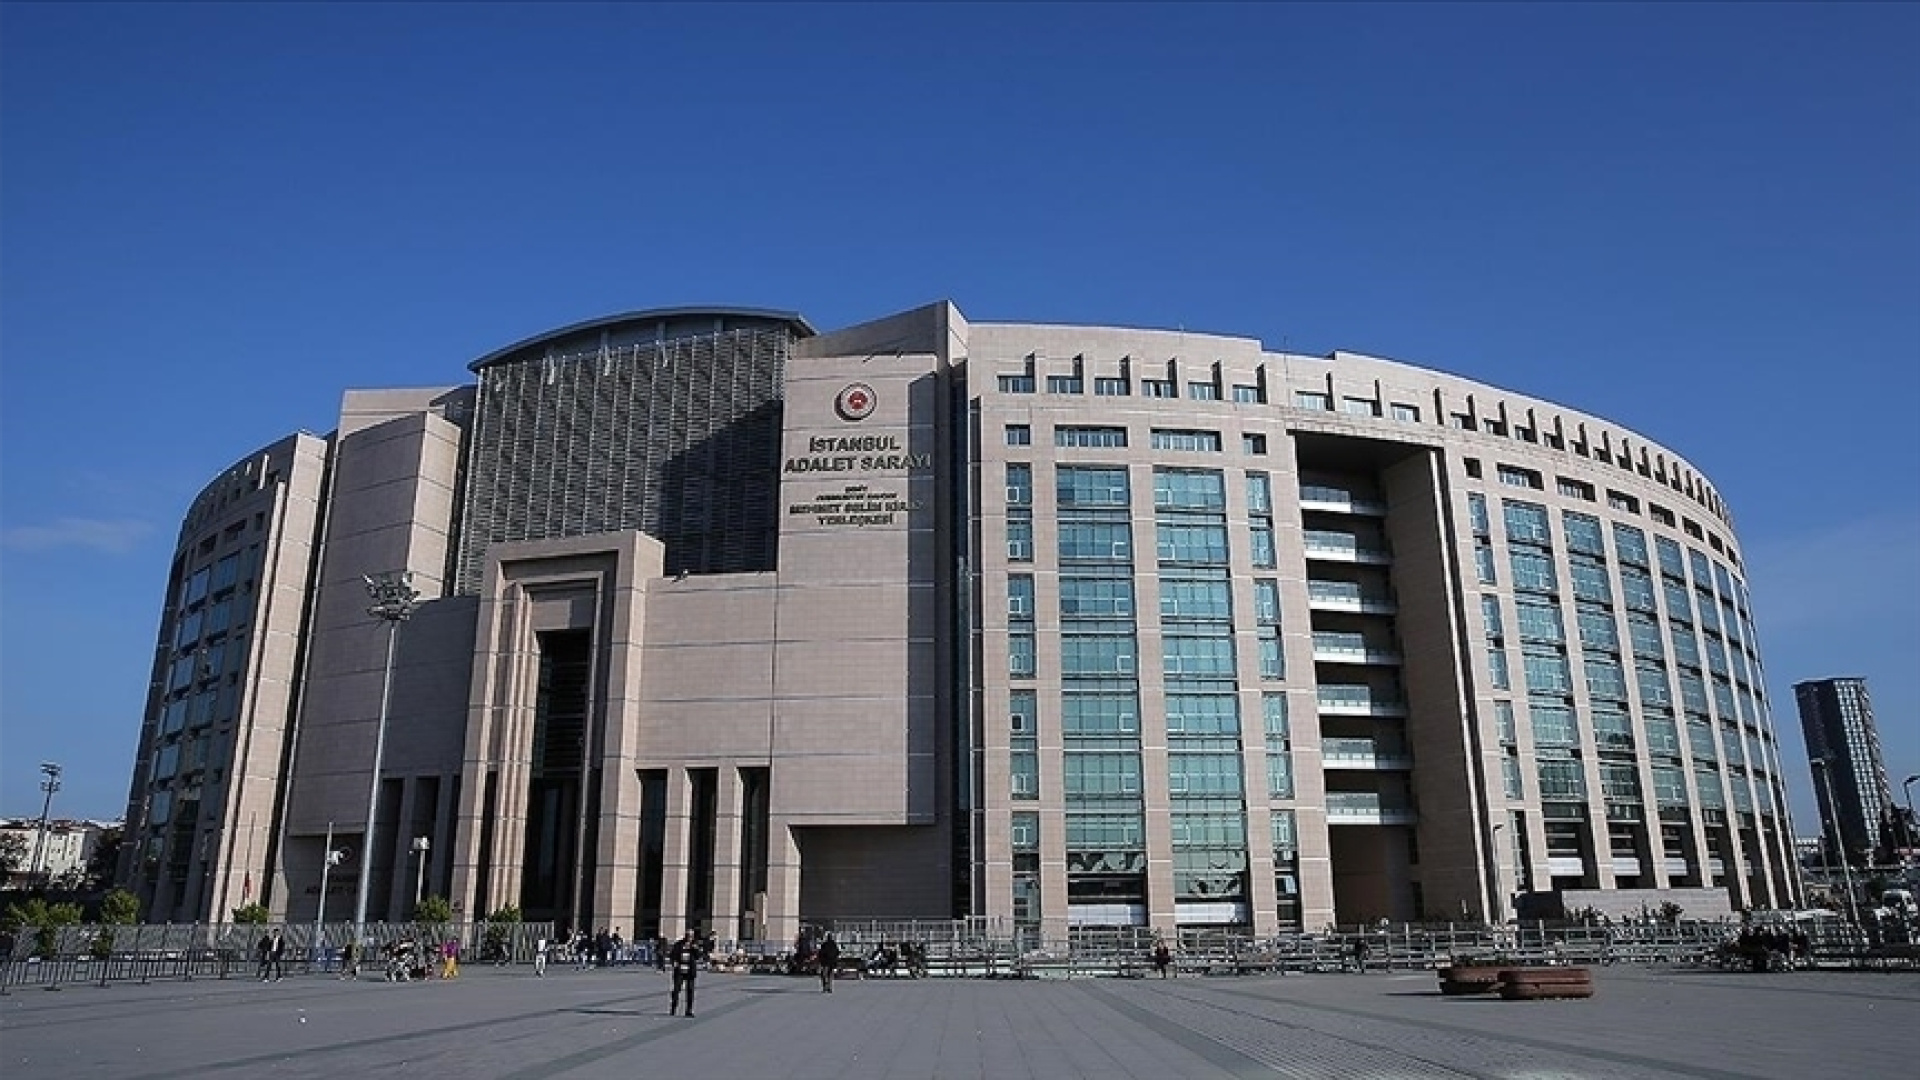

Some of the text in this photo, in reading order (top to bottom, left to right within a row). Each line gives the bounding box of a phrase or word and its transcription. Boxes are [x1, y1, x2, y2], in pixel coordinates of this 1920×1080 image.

[808, 435, 901, 452] İSTANBUL
[784, 453, 931, 472] ADALET SARAYI
